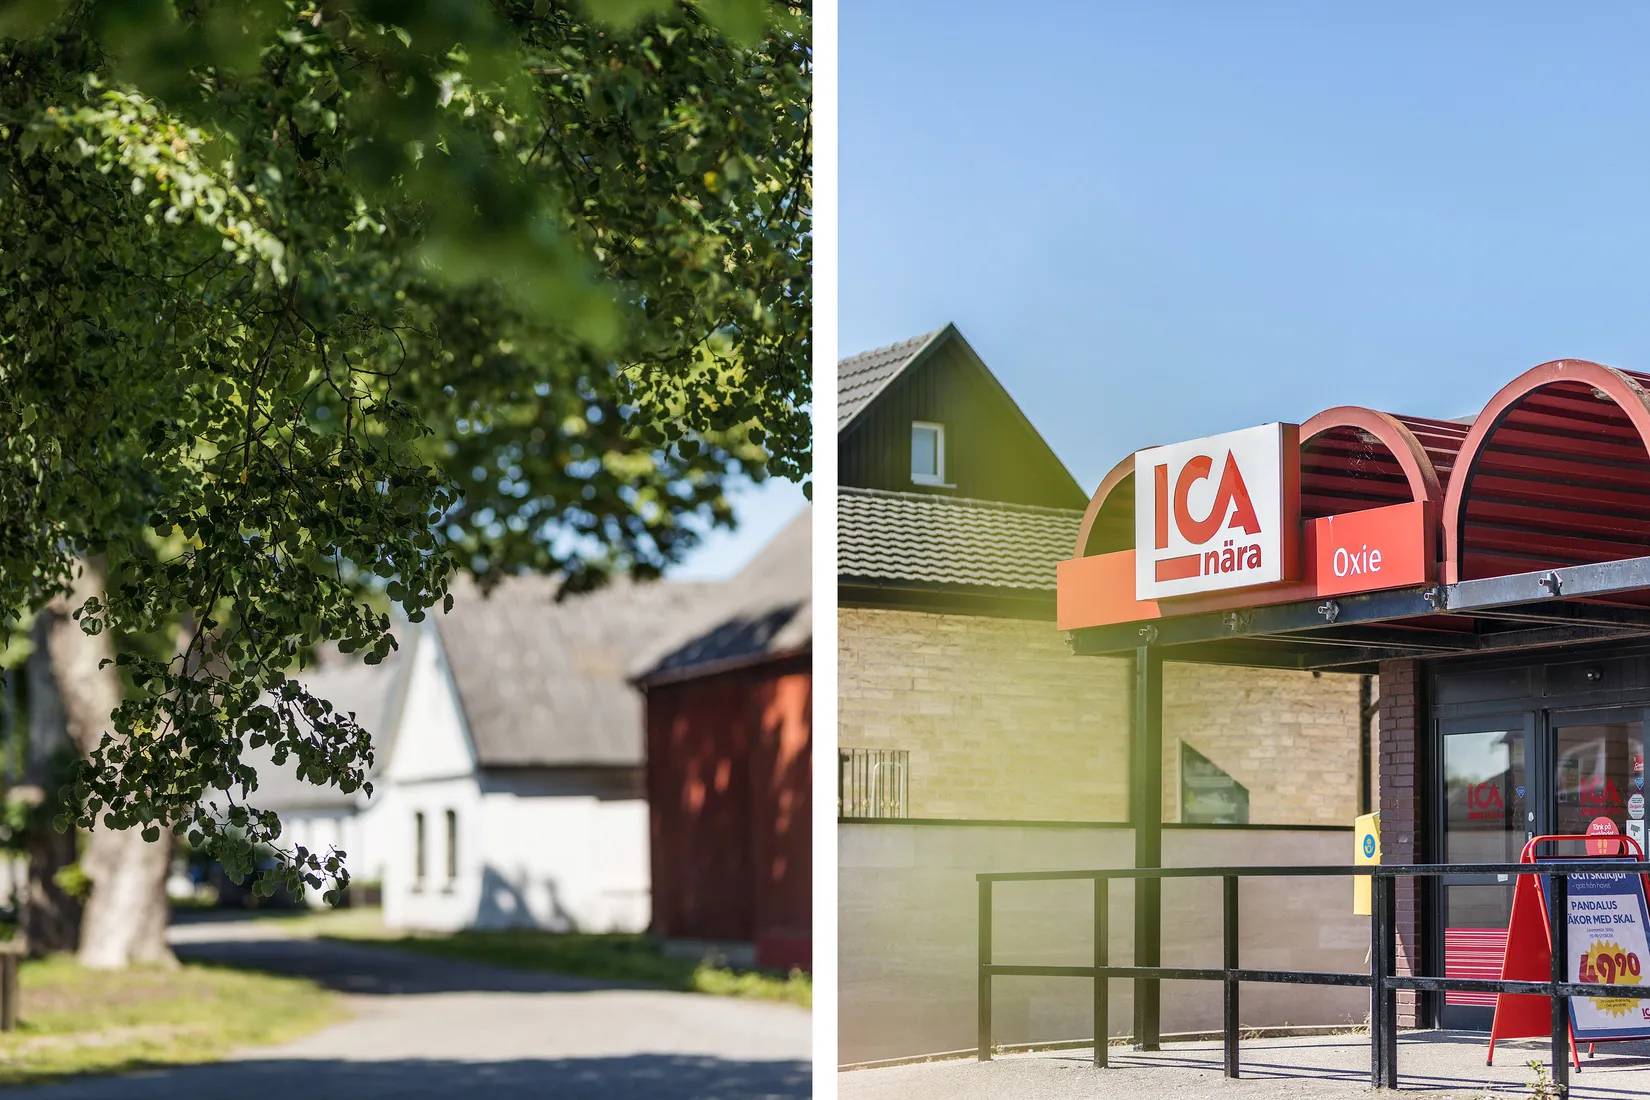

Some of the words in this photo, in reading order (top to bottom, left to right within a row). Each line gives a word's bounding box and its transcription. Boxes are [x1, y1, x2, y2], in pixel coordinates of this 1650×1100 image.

[1154, 448, 1262, 550] ICA
[1203, 539, 1262, 576] nära
[1333, 544, 1382, 577] Oxie
[1467, 782, 1505, 810] ICA
[1581, 776, 1622, 805] ICA
[1567, 913, 1592, 925] ÄKOR
[1593, 914, 1612, 924] MED
[1613, 913, 1636, 924] SKAL
[1571, 900, 1618, 911] PANDALUS
